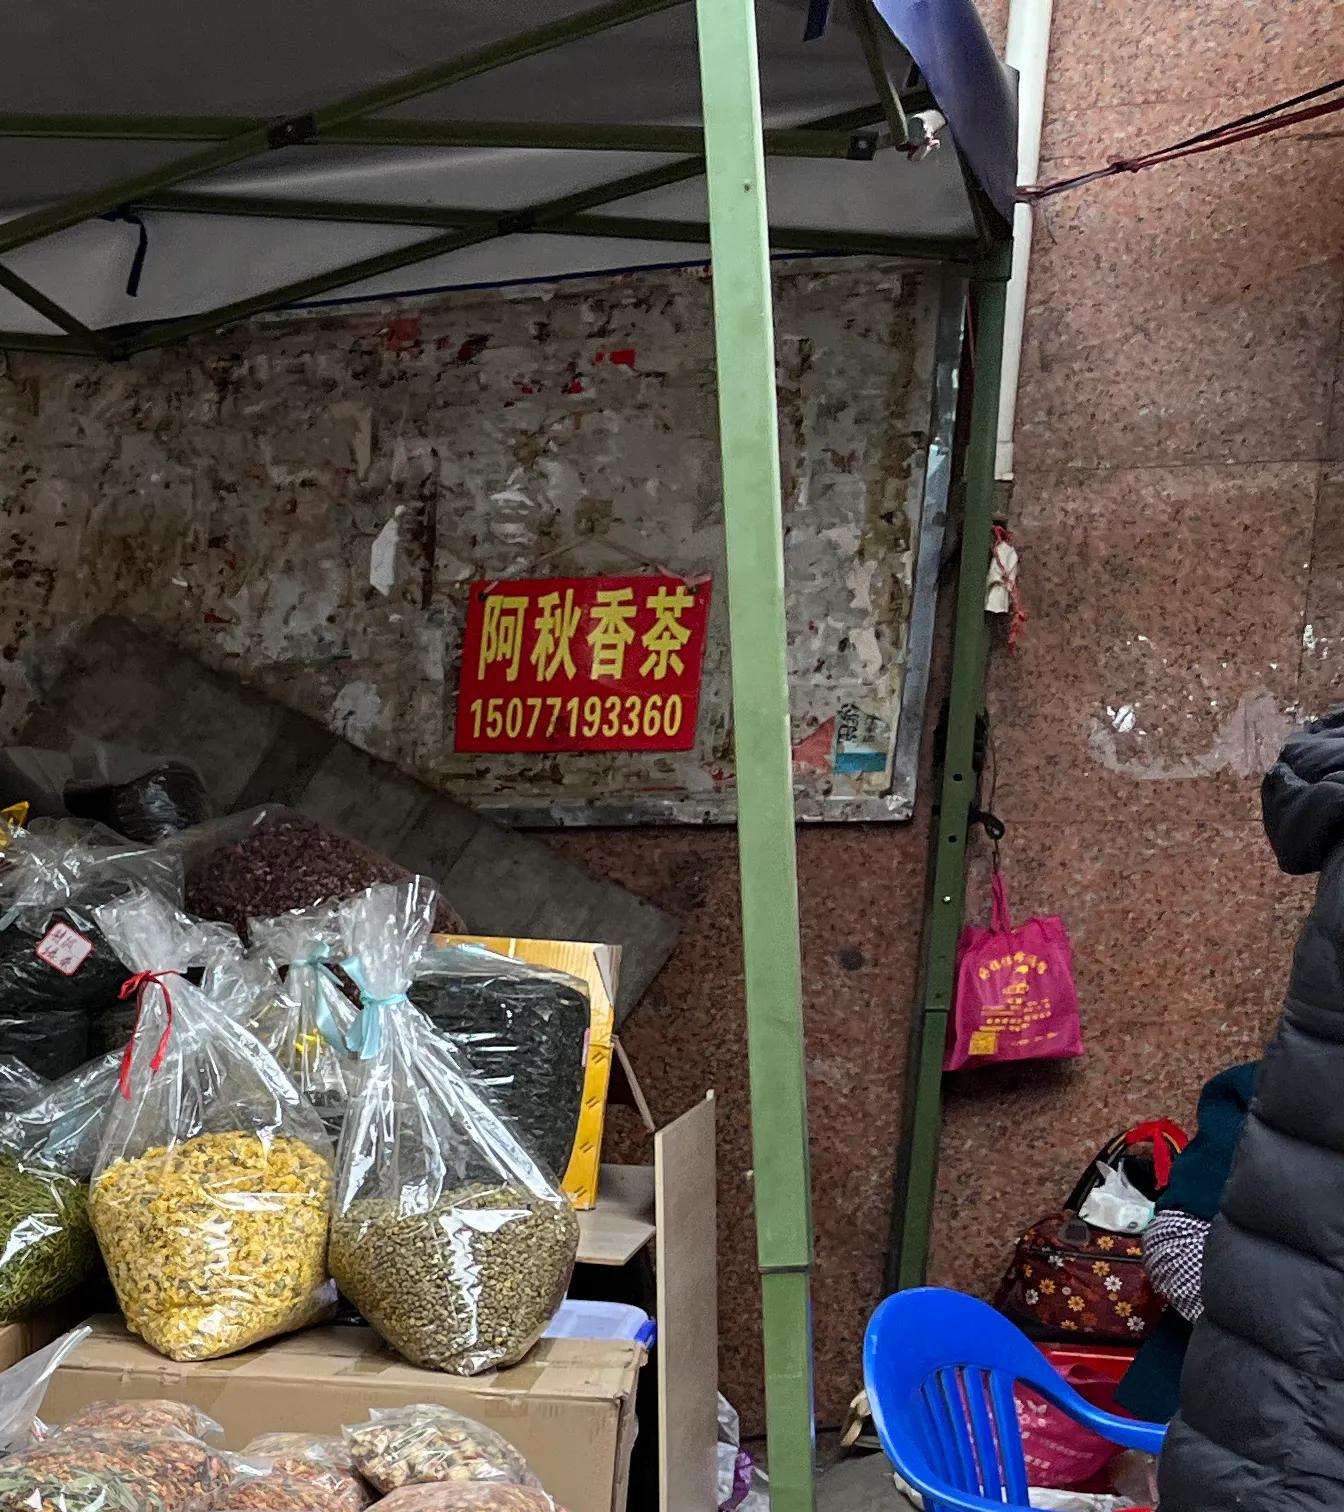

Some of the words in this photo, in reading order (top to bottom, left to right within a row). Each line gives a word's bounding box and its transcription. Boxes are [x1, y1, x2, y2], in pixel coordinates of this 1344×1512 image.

[478, 586, 695, 681] 阿秋香茶
[471, 694, 683, 739] 15077193360
